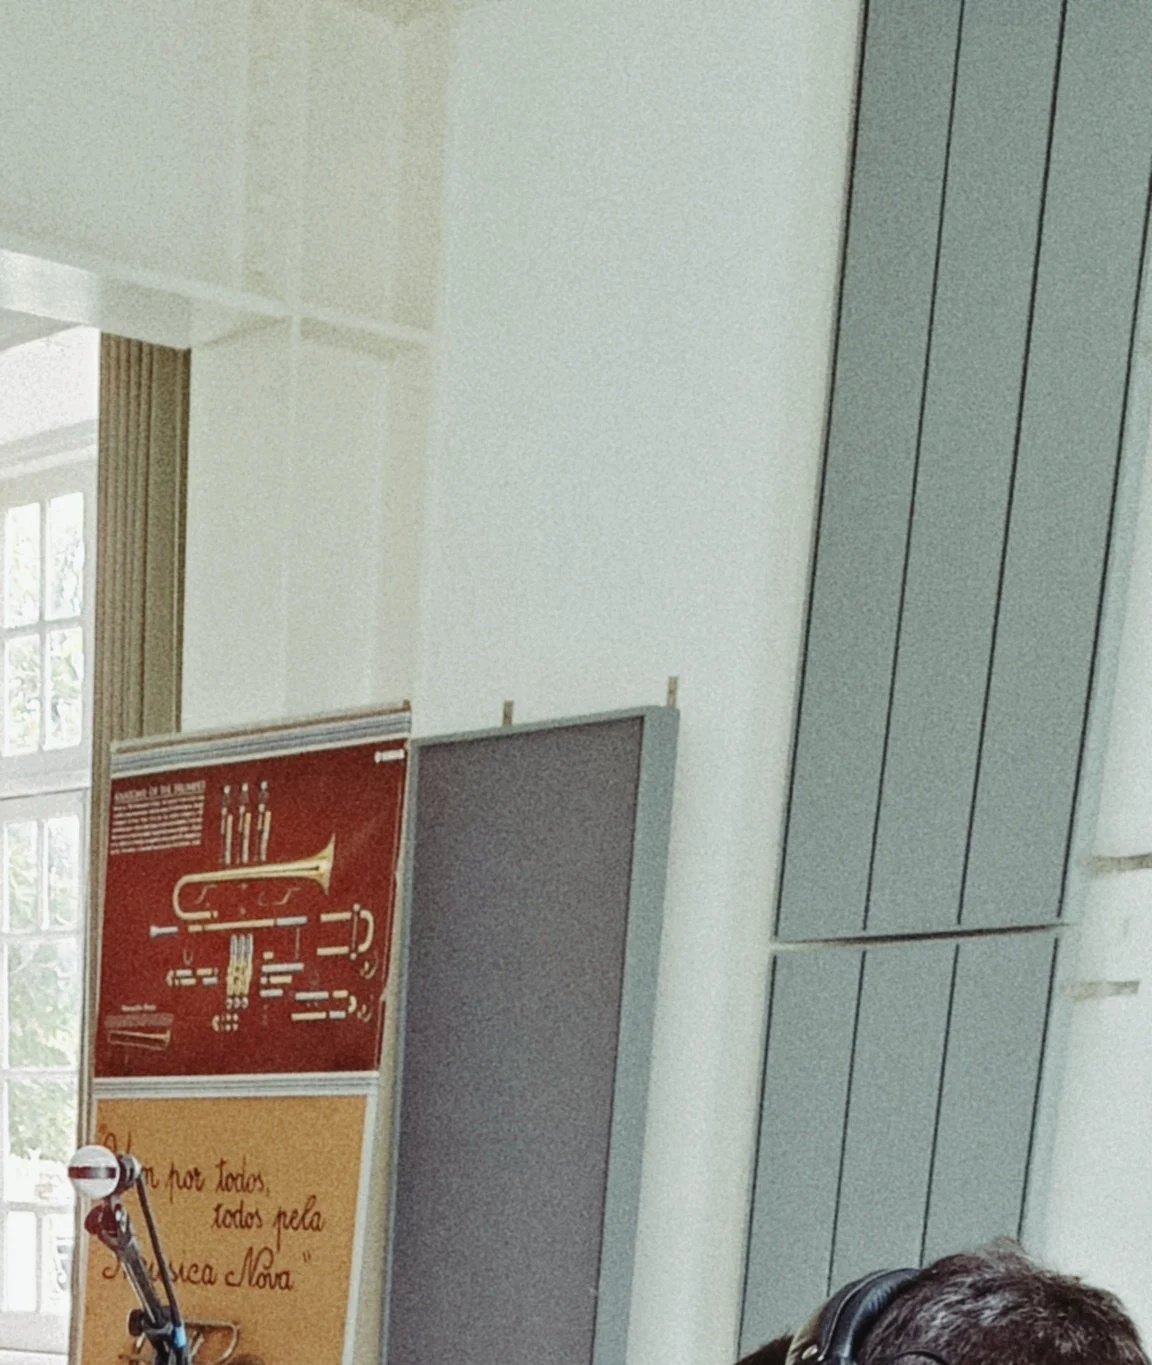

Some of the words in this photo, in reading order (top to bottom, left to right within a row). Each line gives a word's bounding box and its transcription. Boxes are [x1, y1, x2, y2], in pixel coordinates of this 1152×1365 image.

[163, 1161, 205, 1204] por
[215, 1156, 269, 1197] todos,
[210, 1199, 262, 1229] todos
[272, 1194, 325, 1253] pela
